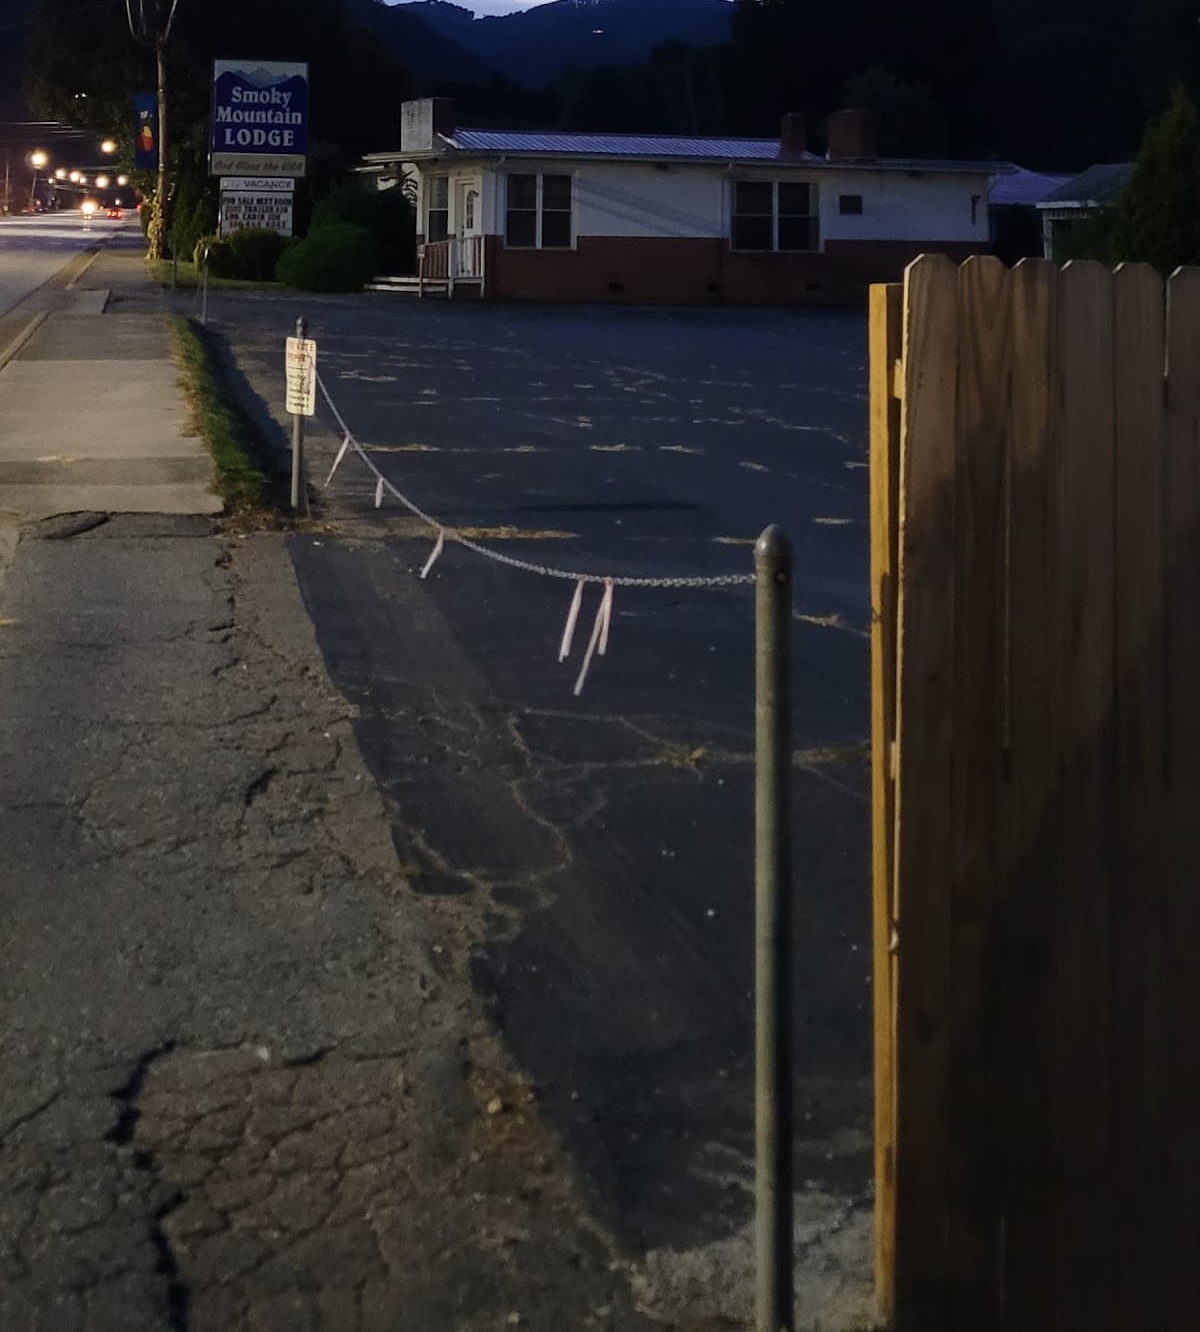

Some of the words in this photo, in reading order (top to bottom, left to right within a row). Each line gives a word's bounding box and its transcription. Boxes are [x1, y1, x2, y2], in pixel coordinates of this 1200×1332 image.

[231, 86, 292, 108] Smoky
[216, 106, 302, 124] Mountain
[224, 128, 294, 146] LODGE
[243, 179, 292, 189] VACANCY
[238, 197, 254, 205] SALE
[244, 205, 273, 213] TRAILER
